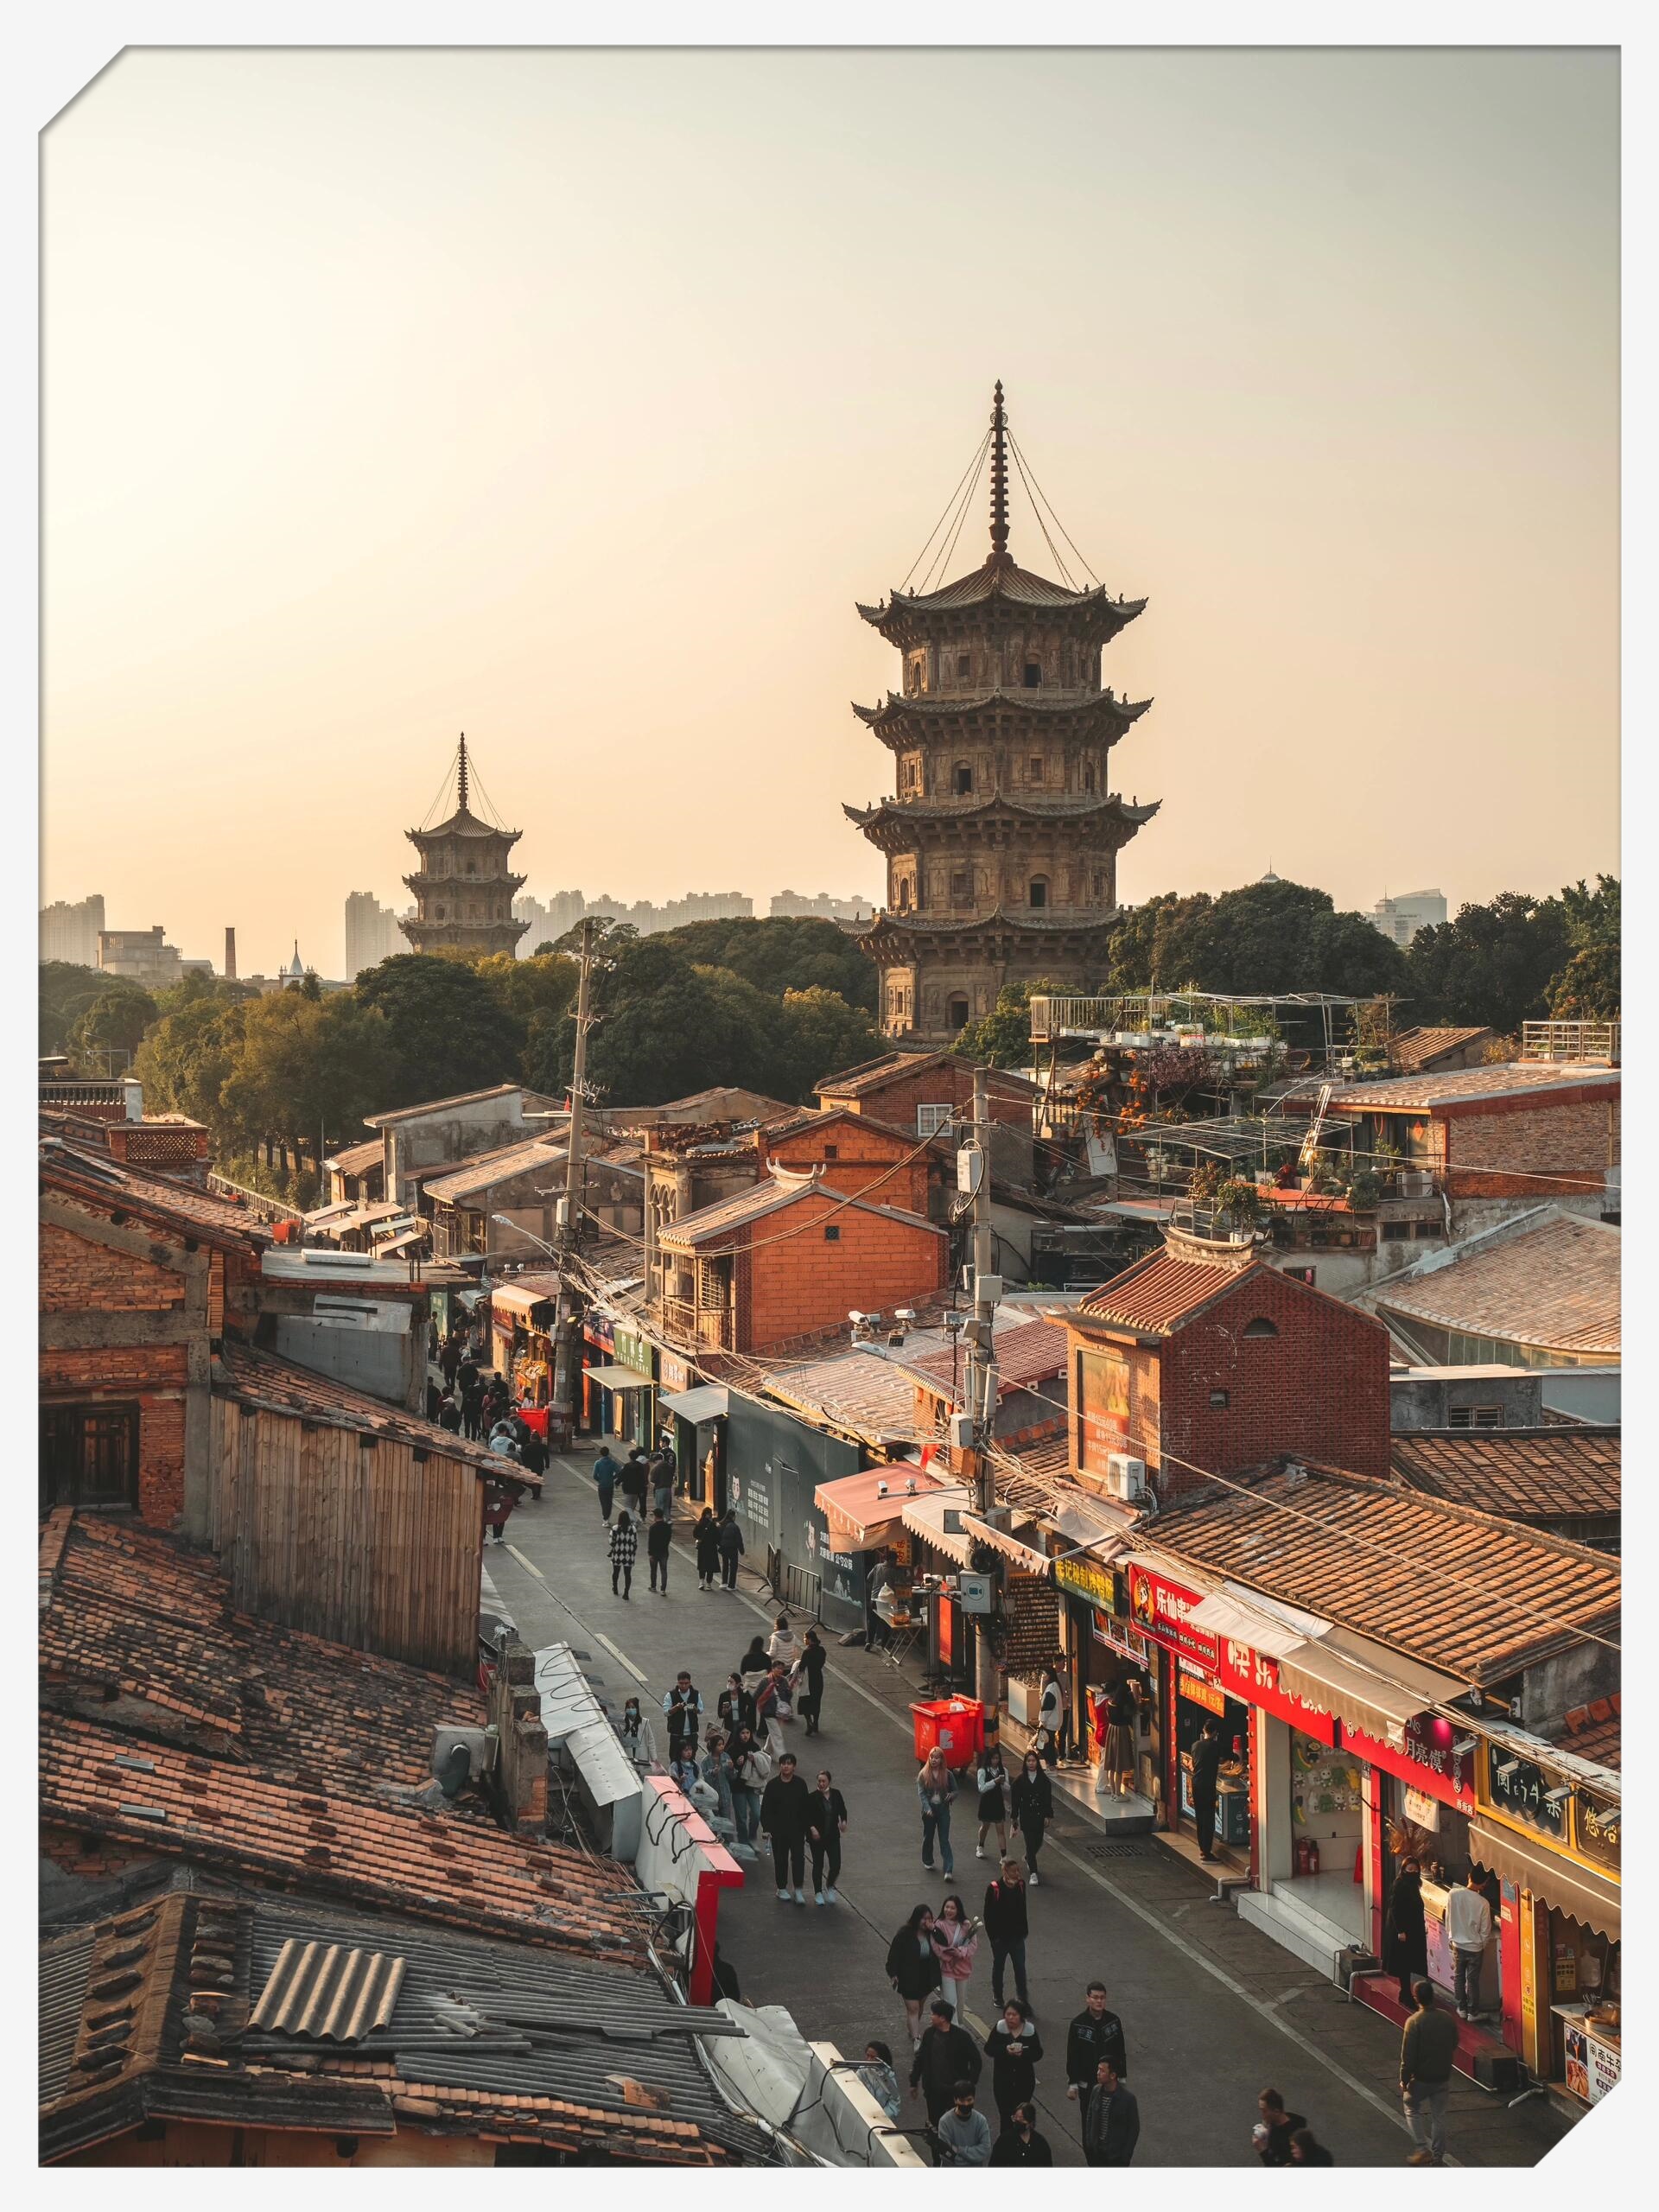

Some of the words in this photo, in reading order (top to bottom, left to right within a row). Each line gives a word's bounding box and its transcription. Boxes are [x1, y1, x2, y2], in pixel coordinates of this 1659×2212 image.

[1156, 1586, 1195, 1624] 乐仙串
[1407, 1718, 1421, 1735] NS
[1456, 1799, 1473, 1815] 西街店
